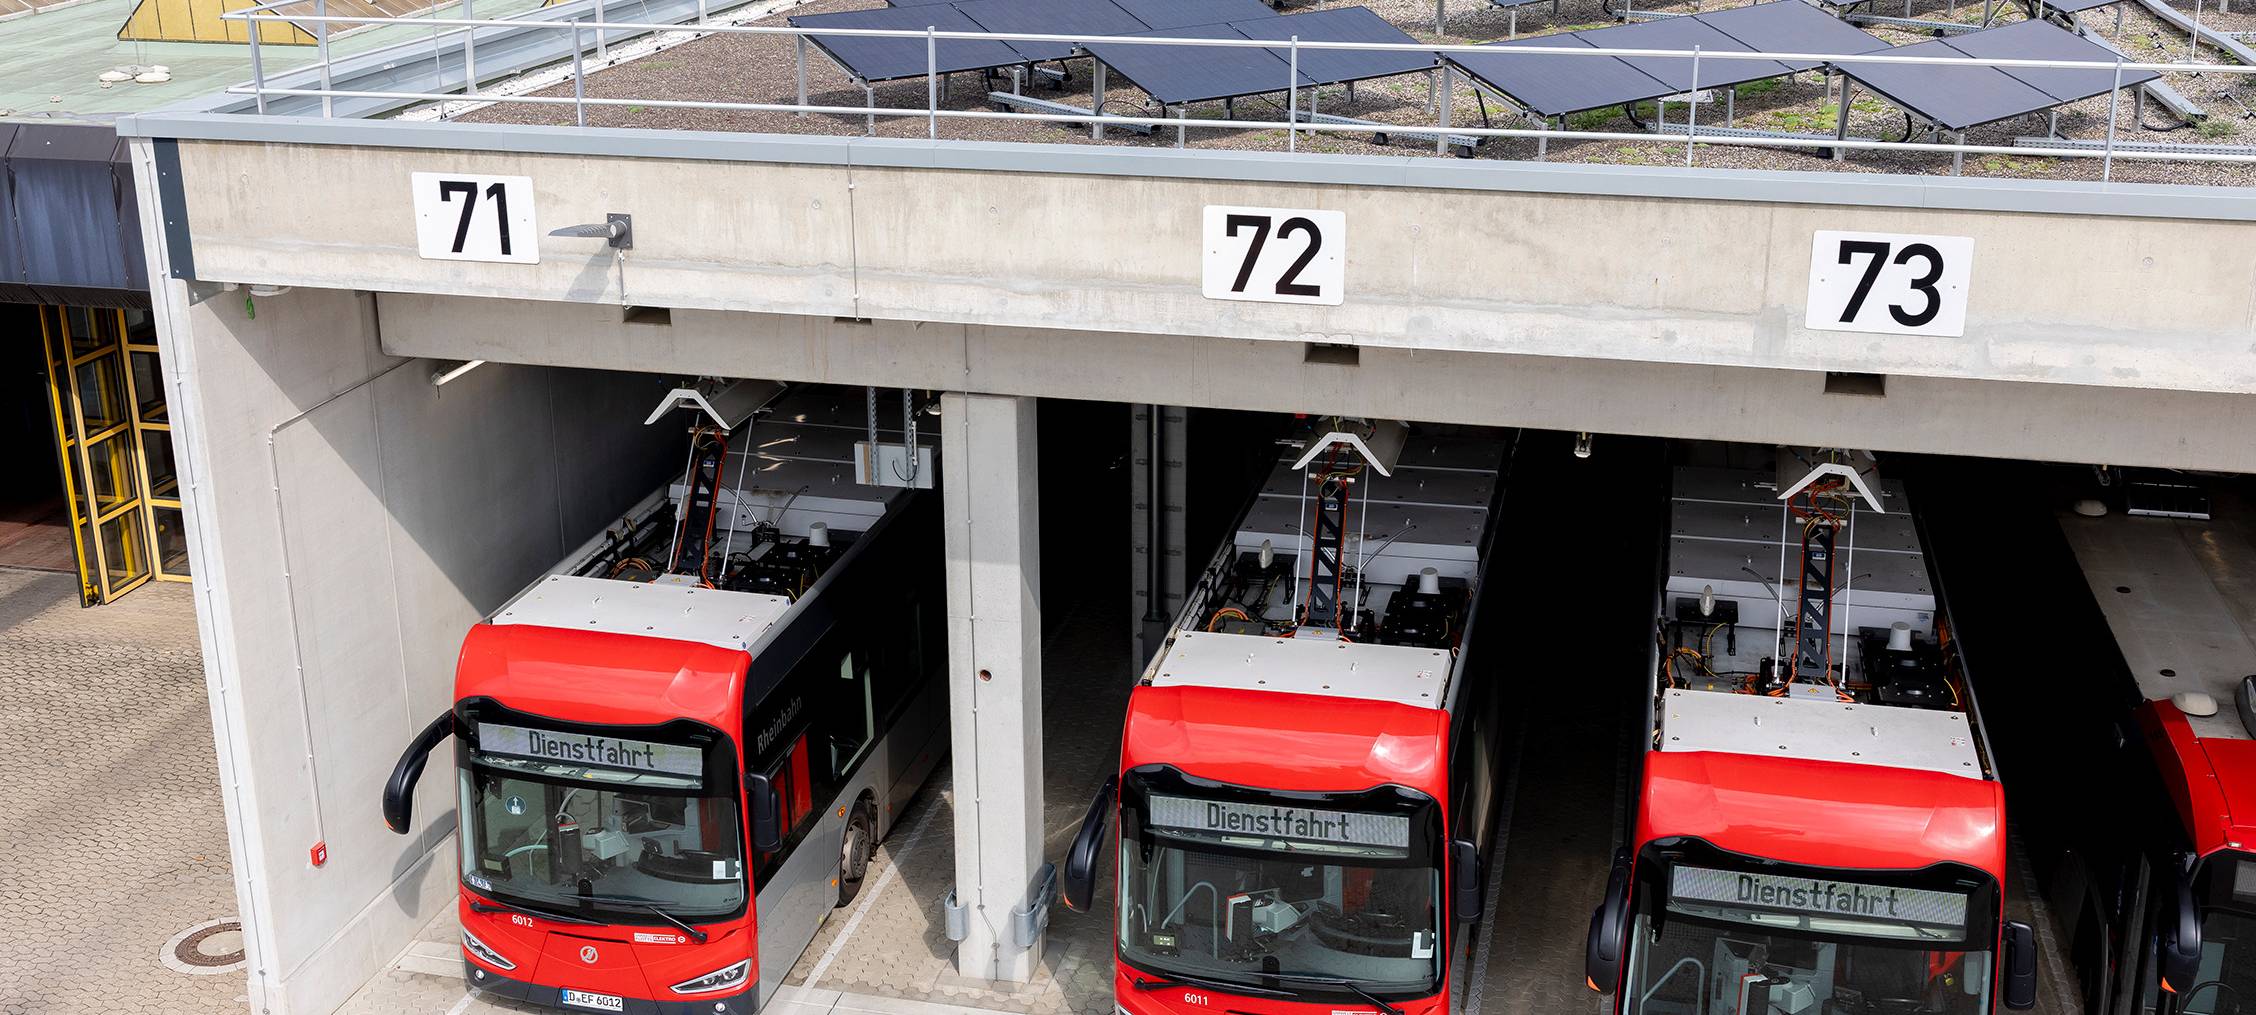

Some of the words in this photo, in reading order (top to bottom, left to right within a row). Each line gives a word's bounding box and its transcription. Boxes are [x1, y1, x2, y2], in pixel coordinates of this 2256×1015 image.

[439, 180, 512, 256] 71
[1226, 214, 1322, 297] 72
[1838, 240, 1944, 327] 73
[757, 696, 802, 755] Rheinbahn
[528, 729, 655, 768] Dienstfahrt
[1207, 802, 1350, 840] Dienstfahrt
[1737, 874, 1900, 917] Dienstfahrt
[511, 914, 533, 928] 6012
[568, 991, 576, 1002] D
[581, 993, 594, 1004] EF
[596, 996, 622, 1008] 6012
[1184, 993, 1209, 1006] 6011
